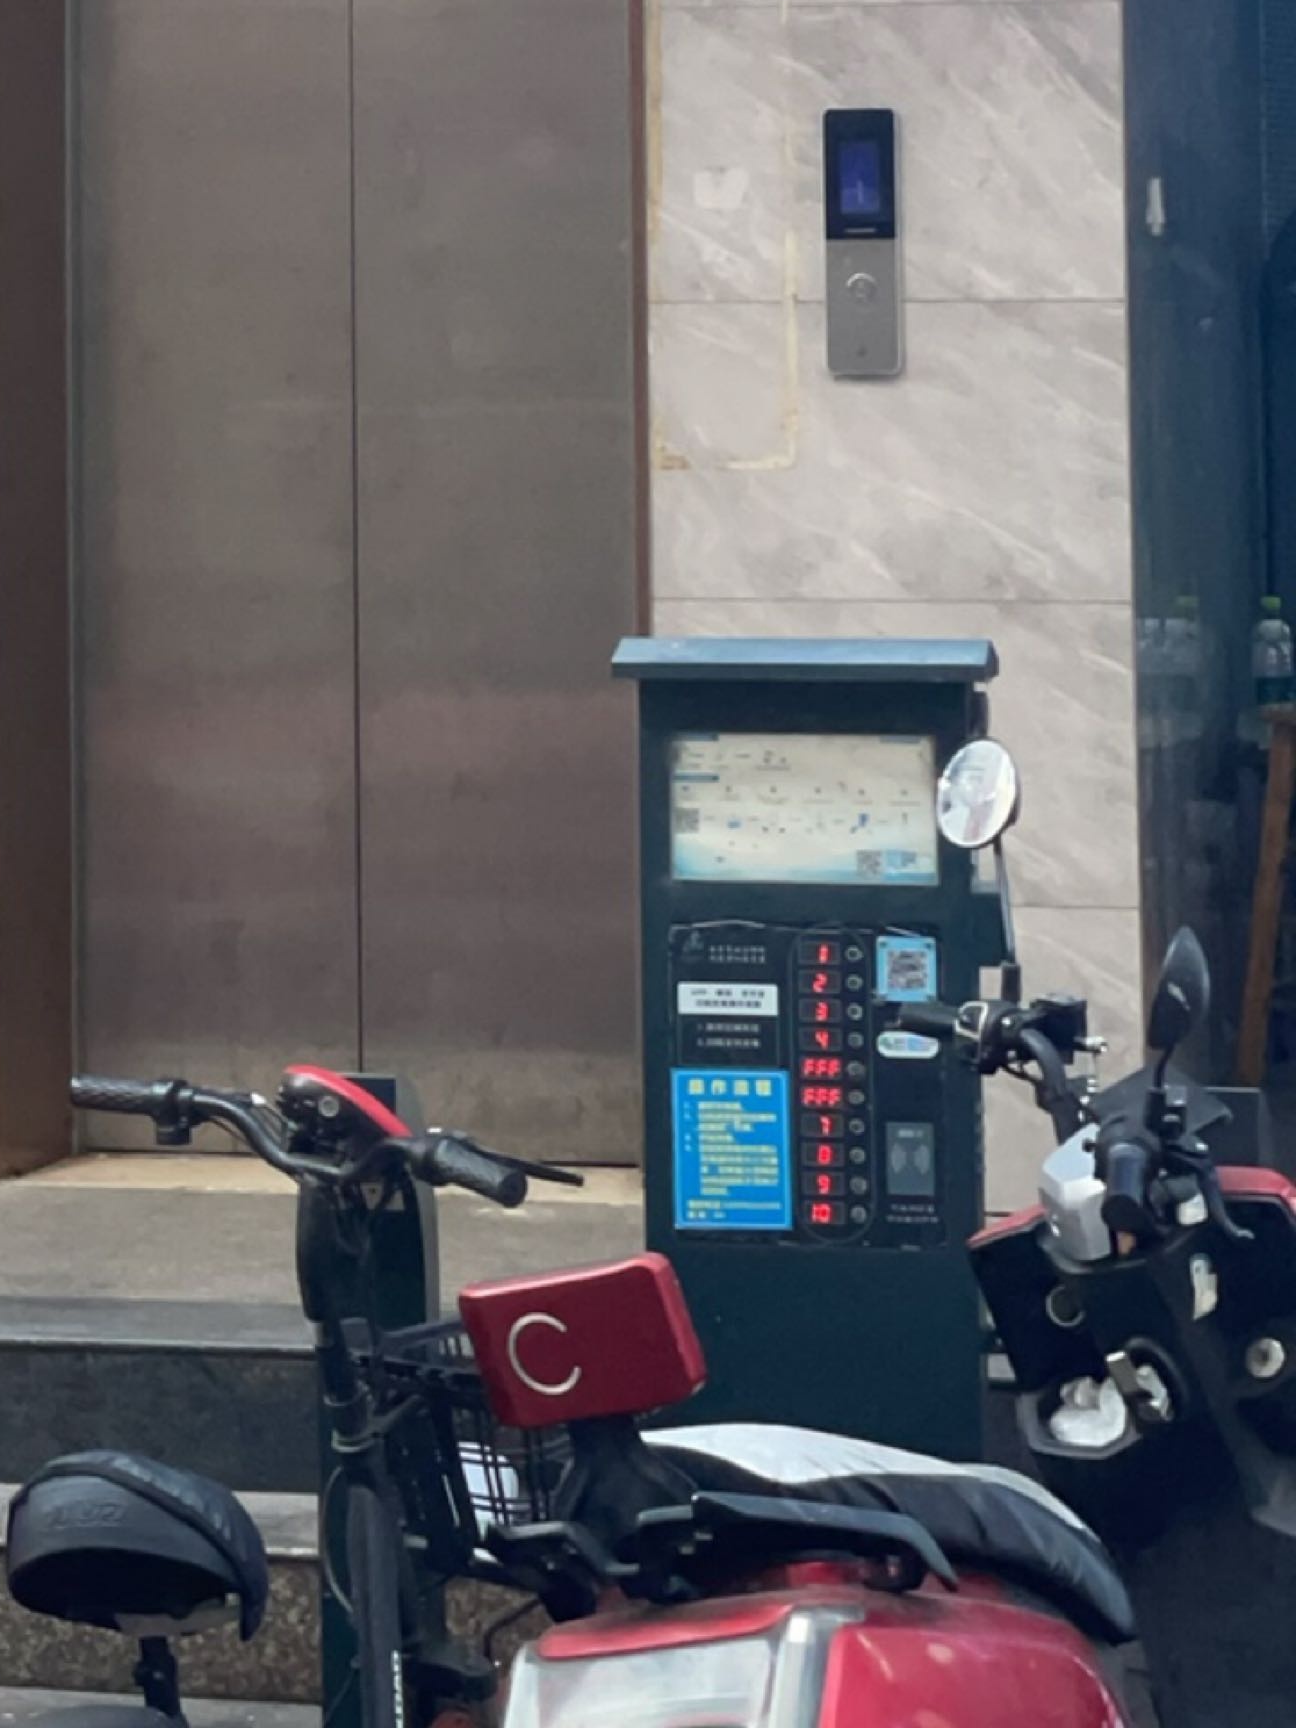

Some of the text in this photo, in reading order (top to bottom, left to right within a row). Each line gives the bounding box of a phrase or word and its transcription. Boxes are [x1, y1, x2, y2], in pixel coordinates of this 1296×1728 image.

[812, 972, 828, 993] 2
[815, 1001, 830, 1022] 3
[815, 1029, 830, 1049] 4
